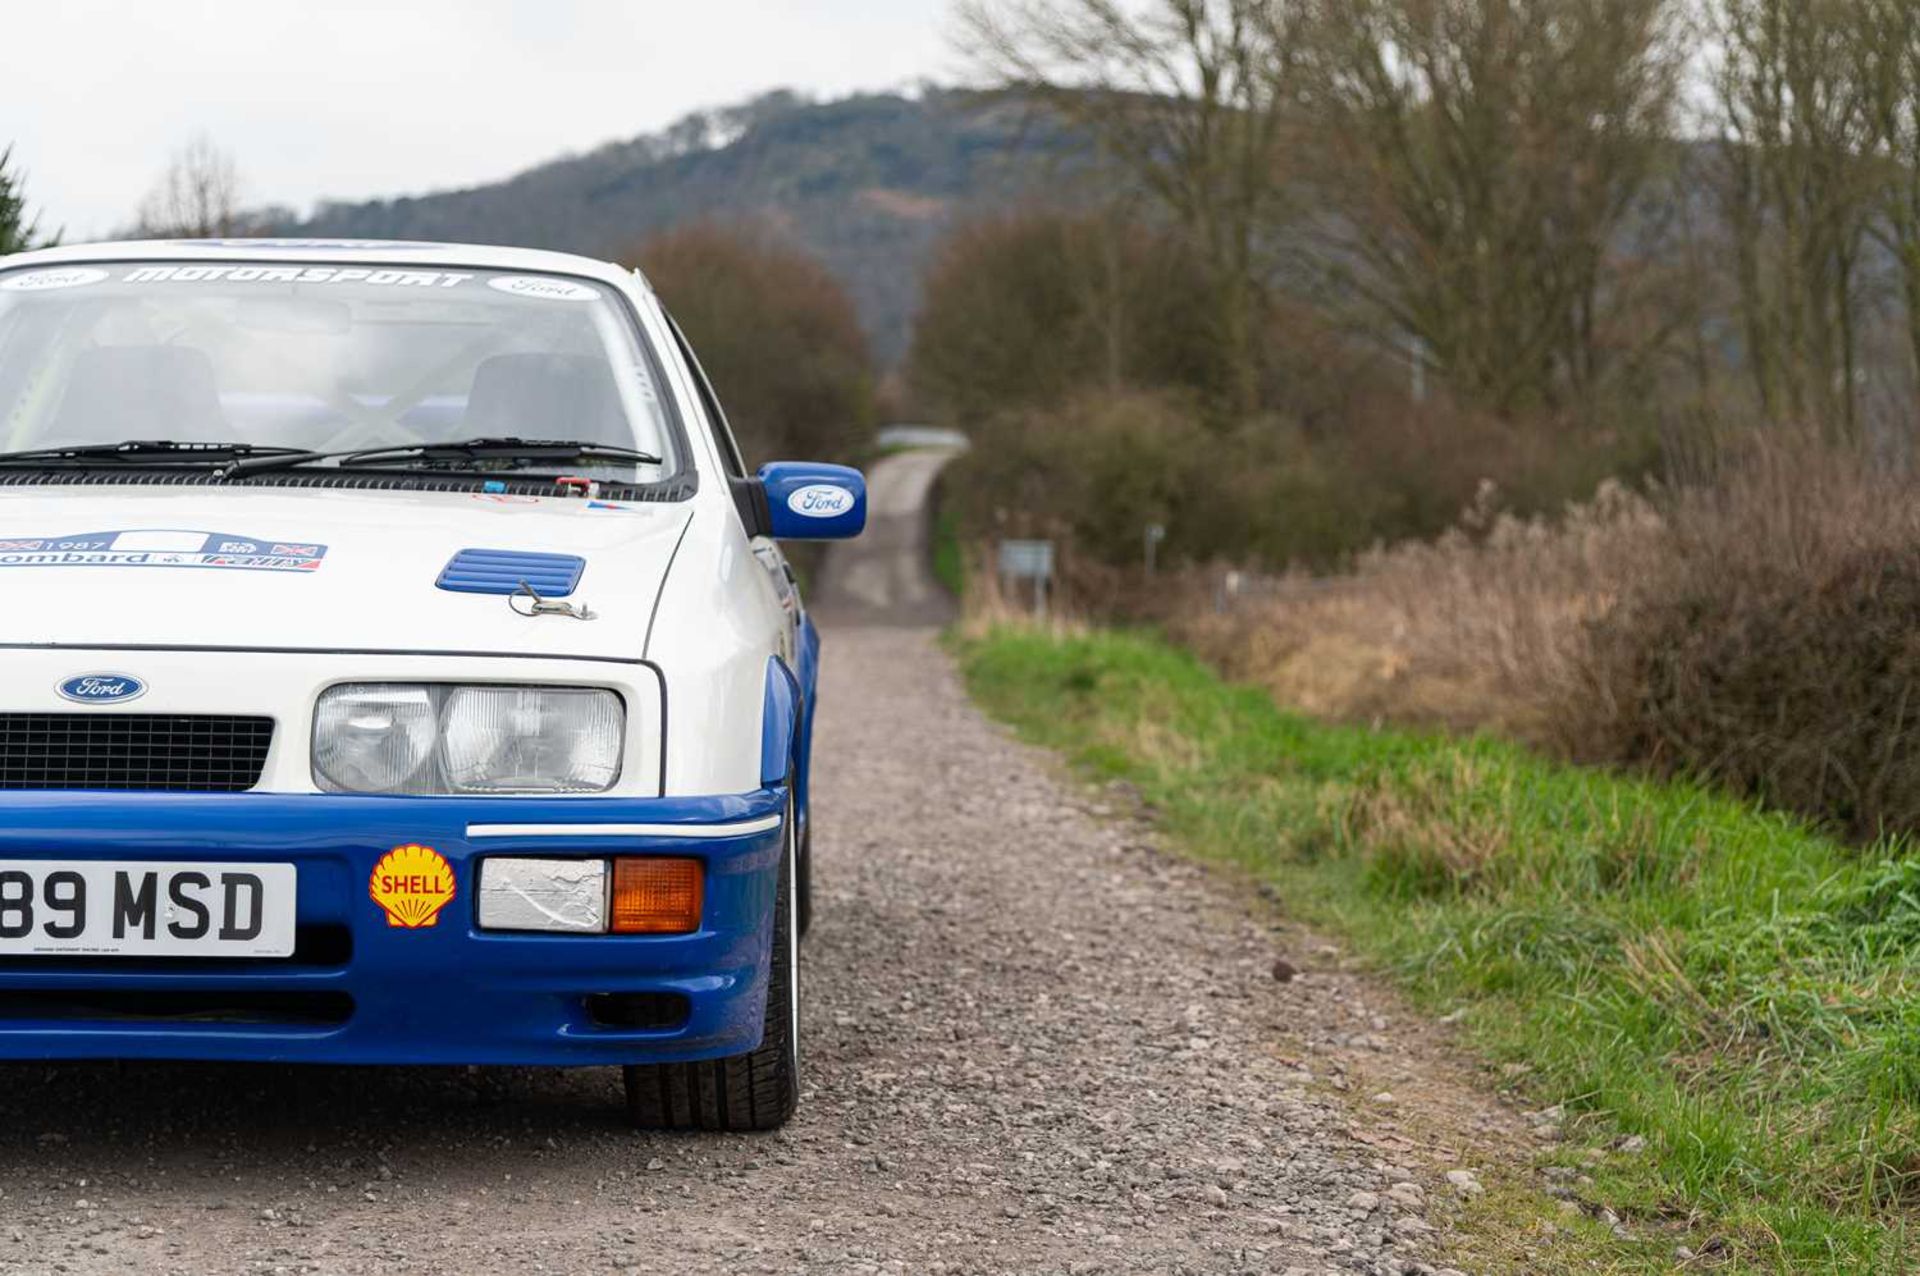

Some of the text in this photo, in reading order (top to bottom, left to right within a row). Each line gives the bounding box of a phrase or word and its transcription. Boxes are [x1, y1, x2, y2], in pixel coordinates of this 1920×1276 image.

[122, 266, 474, 287] MOTORSPORT
[803, 489, 844, 509] Ford
[0, 553, 150, 563] ombard
[76, 678, 126, 695] Ford
[381, 874, 445, 894] SHELL
[113, 870, 264, 941] MSD
